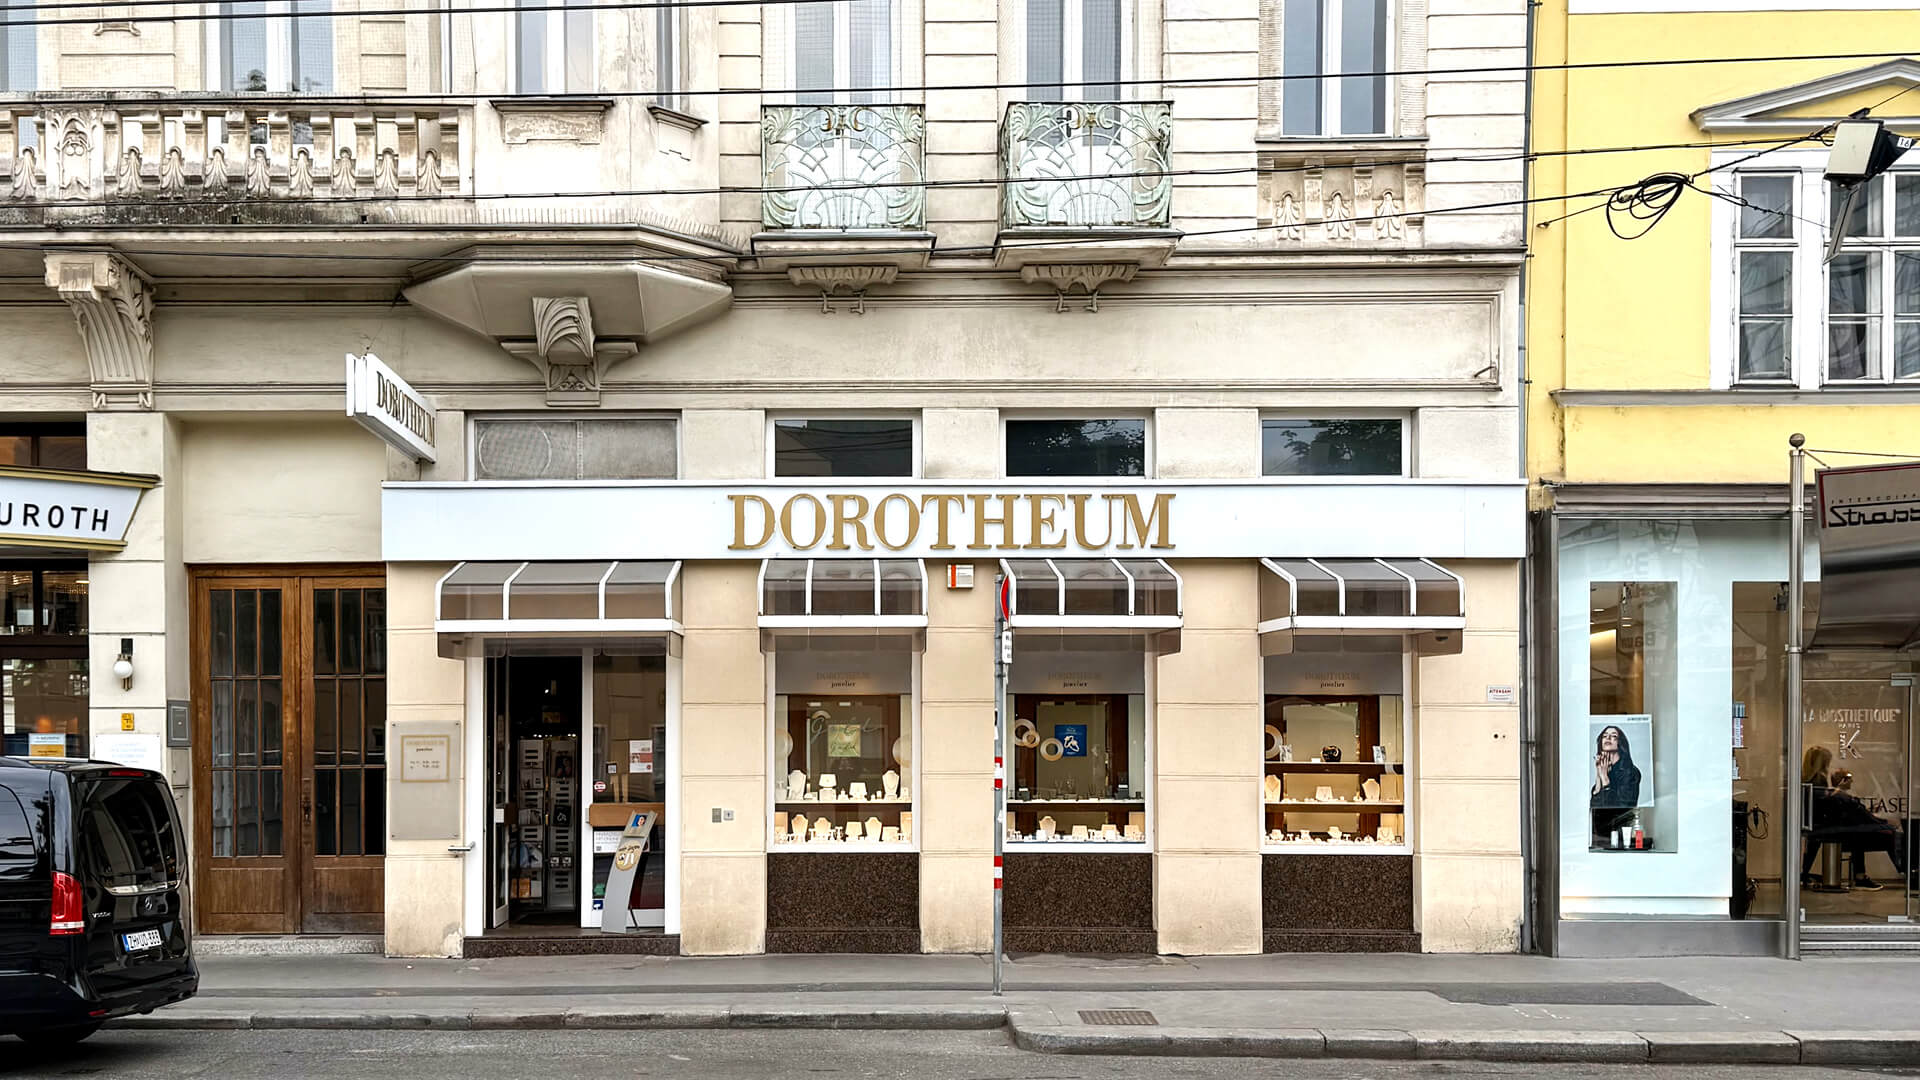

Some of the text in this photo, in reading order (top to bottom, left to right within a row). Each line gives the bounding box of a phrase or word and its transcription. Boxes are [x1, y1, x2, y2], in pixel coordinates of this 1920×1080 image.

[1899, 138, 1910, 148] 16
[376, 370, 436, 448] DOROTHEUM
[727, 493, 1177, 551] DOROTHEUM
